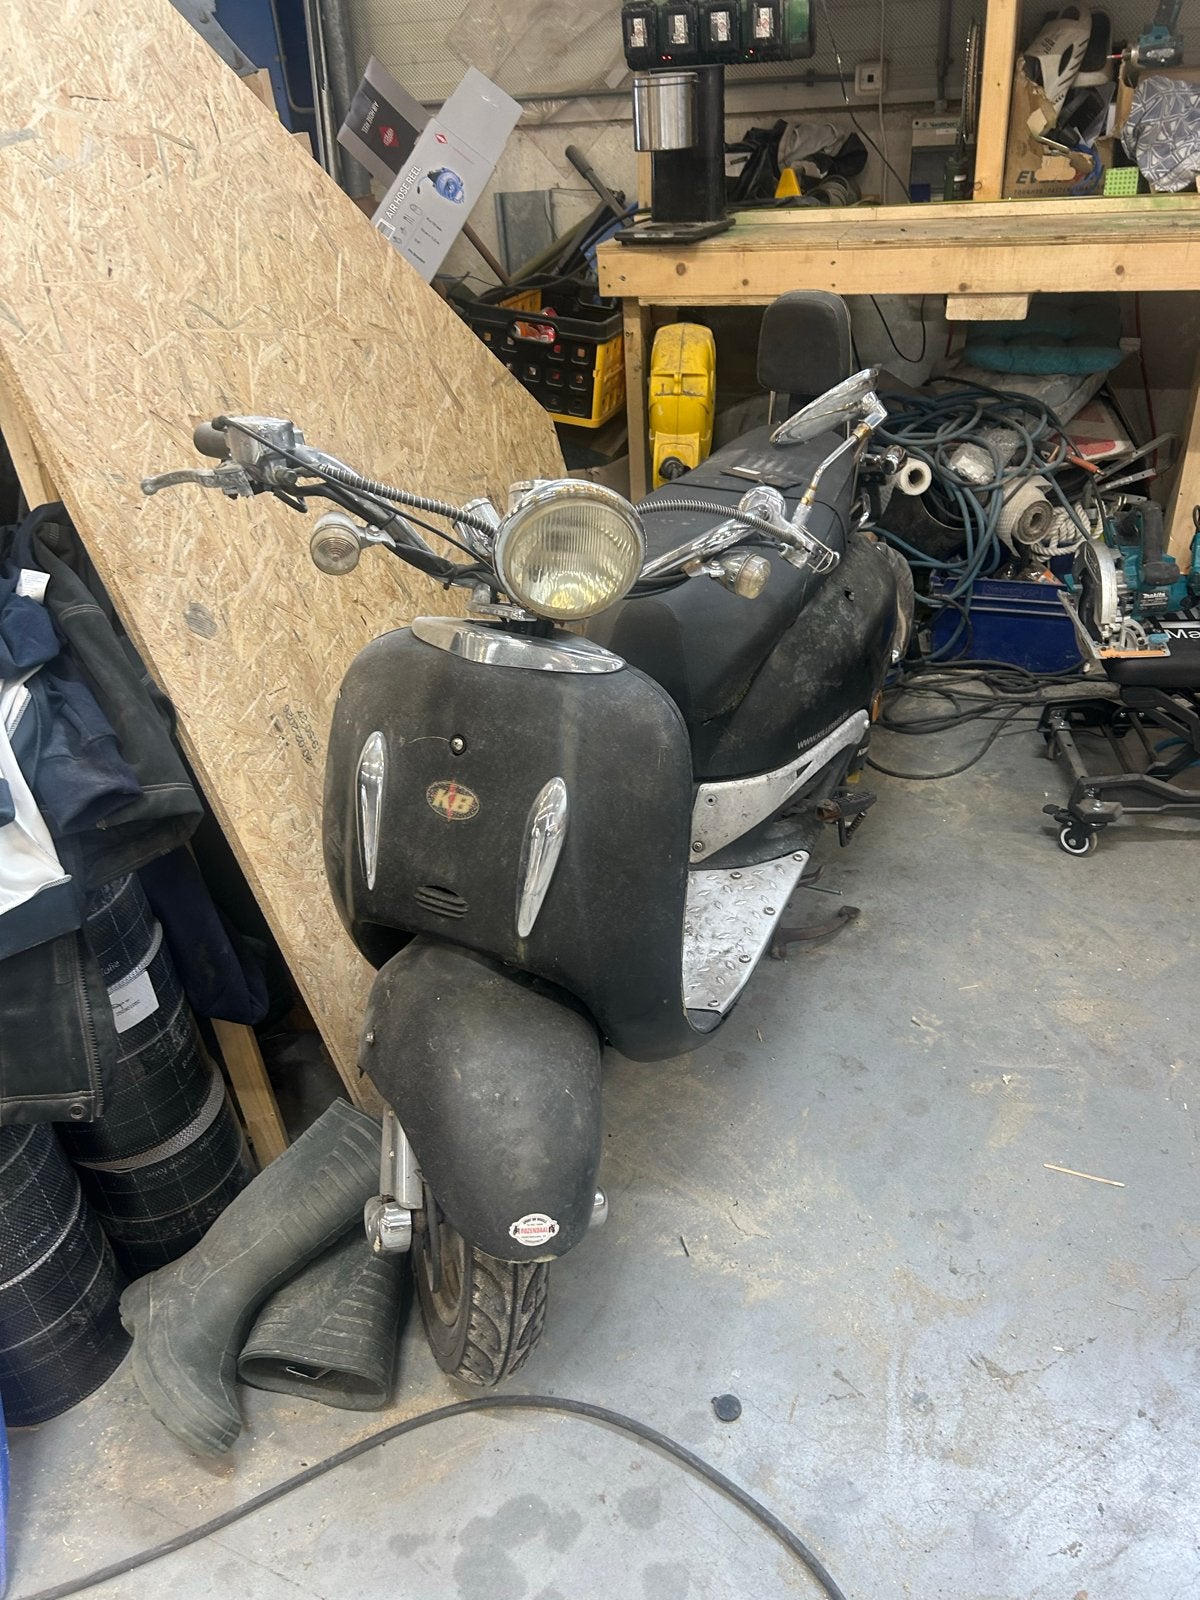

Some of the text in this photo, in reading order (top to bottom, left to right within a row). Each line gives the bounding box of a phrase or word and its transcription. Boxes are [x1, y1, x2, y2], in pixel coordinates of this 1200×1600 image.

[385, 165, 422, 218] AIR HOSE REEL
